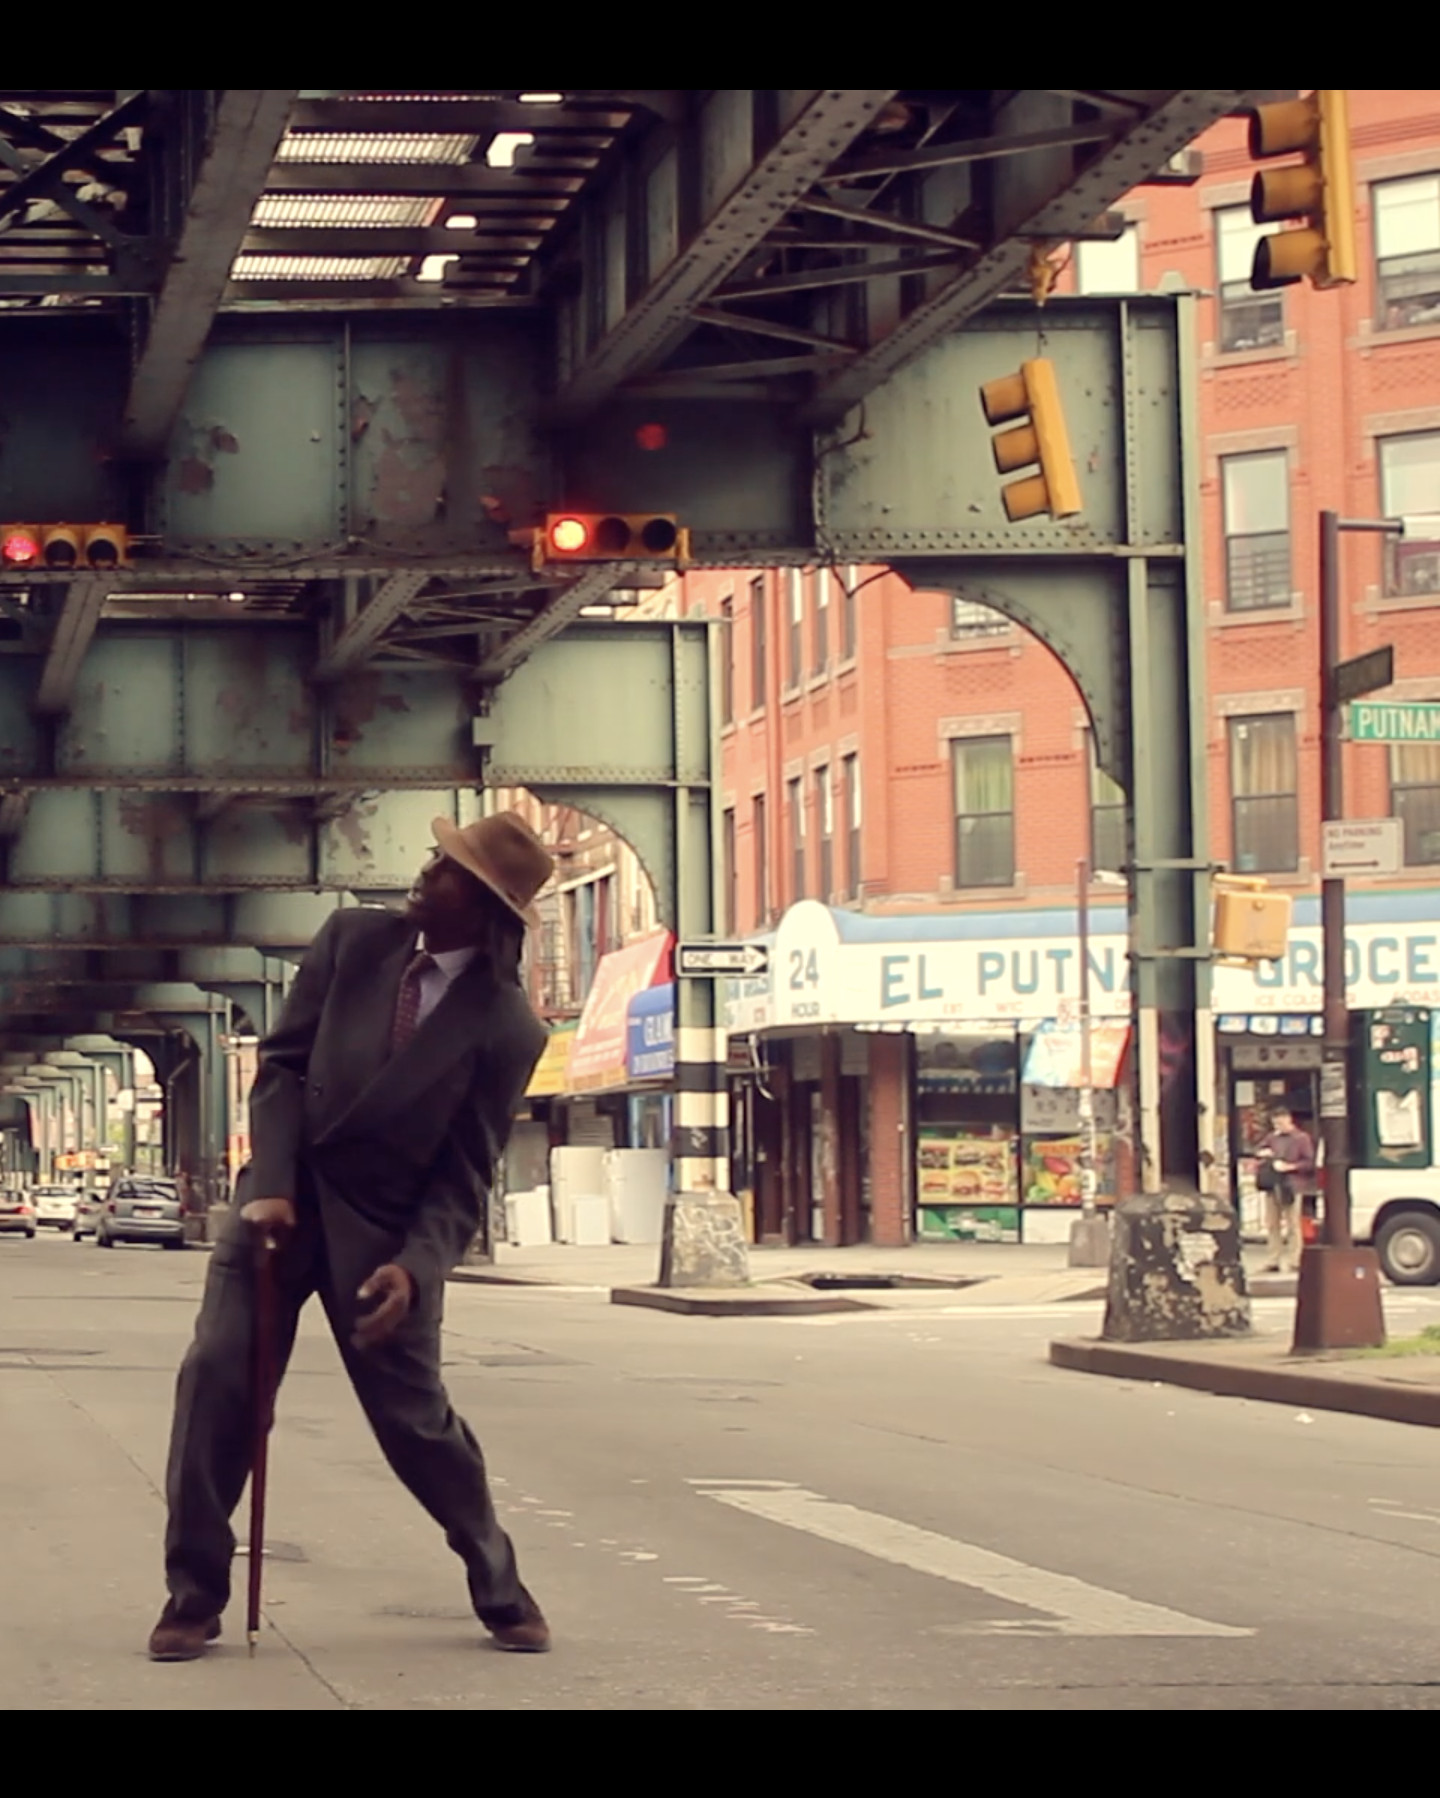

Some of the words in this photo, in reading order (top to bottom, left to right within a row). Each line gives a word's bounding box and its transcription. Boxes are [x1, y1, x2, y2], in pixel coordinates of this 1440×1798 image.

[1342, 825, 1383, 837] PARKING
[686, 952, 711, 966] ONE
[728, 951, 759, 966] WAY
[790, 948, 819, 990] 24
[880, 954, 944, 1010] EL
[790, 1002, 821, 1018] HOUR
